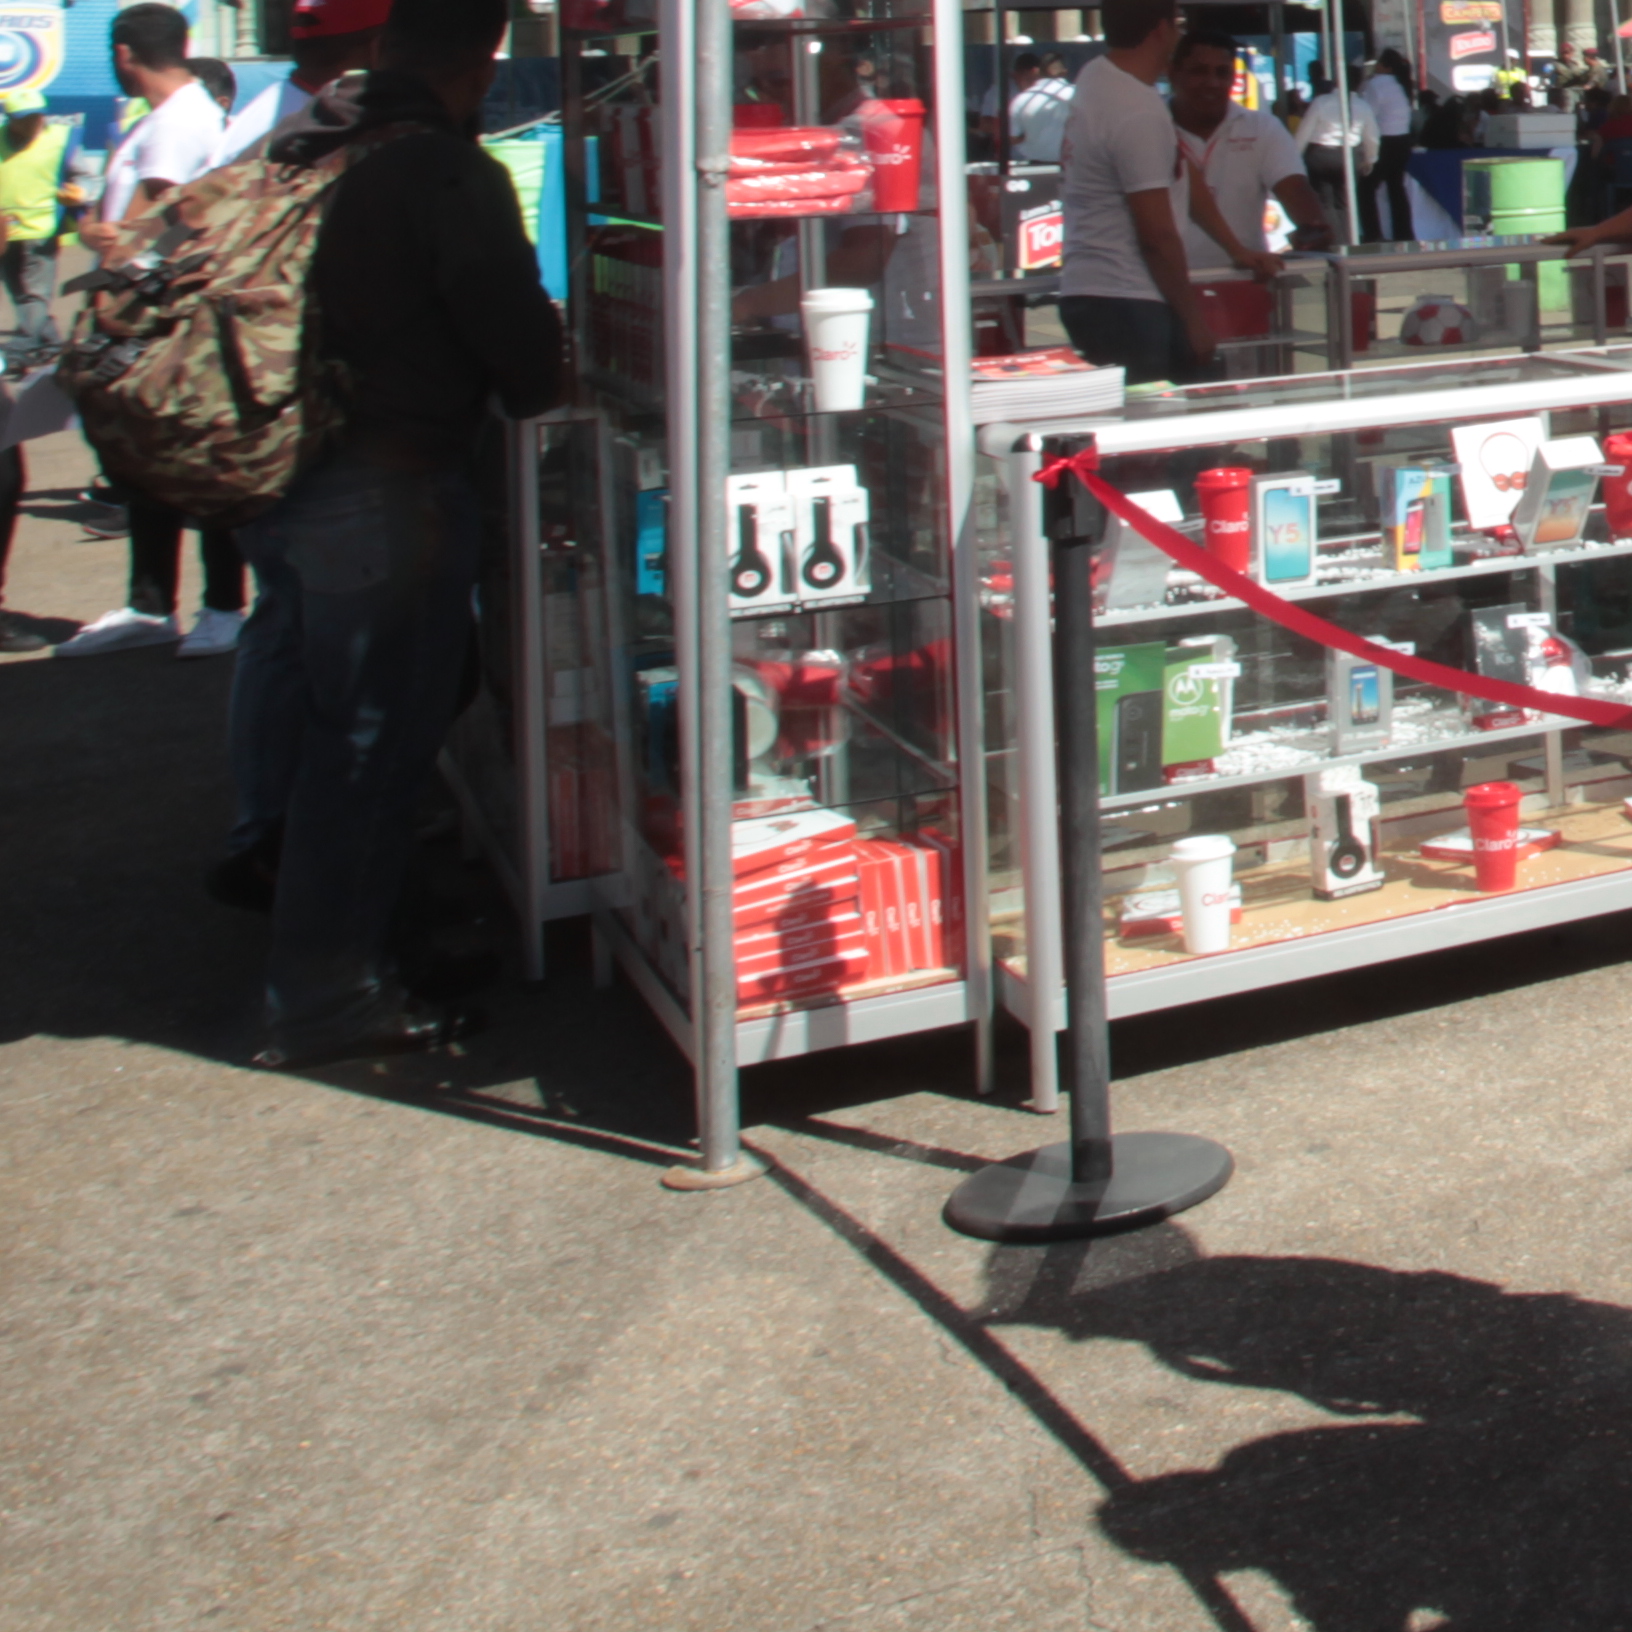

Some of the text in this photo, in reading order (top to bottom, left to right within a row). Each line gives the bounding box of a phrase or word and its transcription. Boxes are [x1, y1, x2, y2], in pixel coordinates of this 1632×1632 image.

[1209, 519, 1249, 535] Claro
[1268, 522, 1300, 545] Y5
[1476, 838, 1515, 852] Claro
